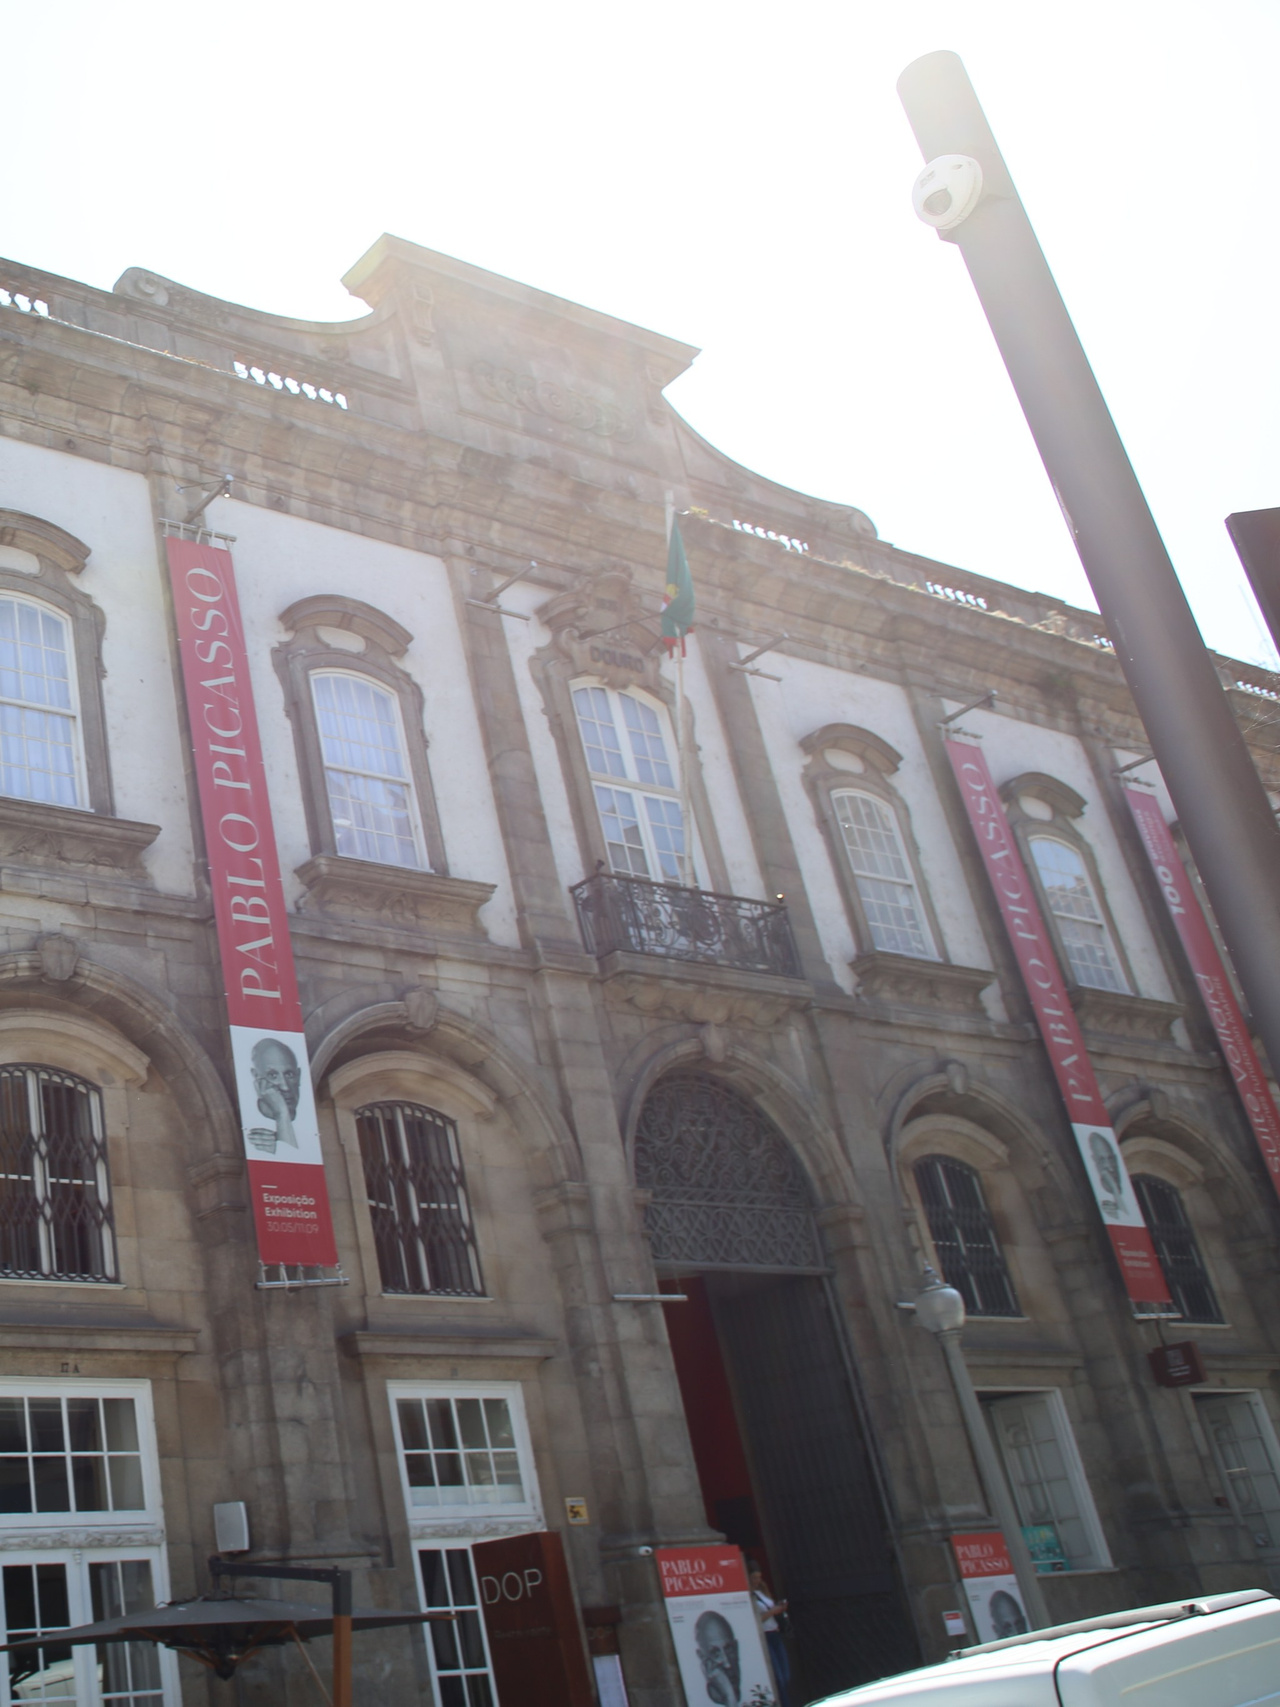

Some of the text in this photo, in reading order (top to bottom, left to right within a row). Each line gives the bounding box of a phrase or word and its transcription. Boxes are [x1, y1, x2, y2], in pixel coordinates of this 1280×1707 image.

[185, 567, 283, 1005] PABLO PICASSO
[1157, 865, 1187, 914] 100
[961, 762, 1094, 1105] PABLO PICASSO
[263, 1193, 316, 1207] Exposição
[264, 1207, 317, 1219] Exhibition
[956, 1543, 994, 1559] PABLO
[660, 1559, 707, 1576] PABLO
[960, 1556, 1010, 1574] PICASSO
[481, 1568, 543, 1604] DOP
[664, 1573, 724, 1592] PICASSO
